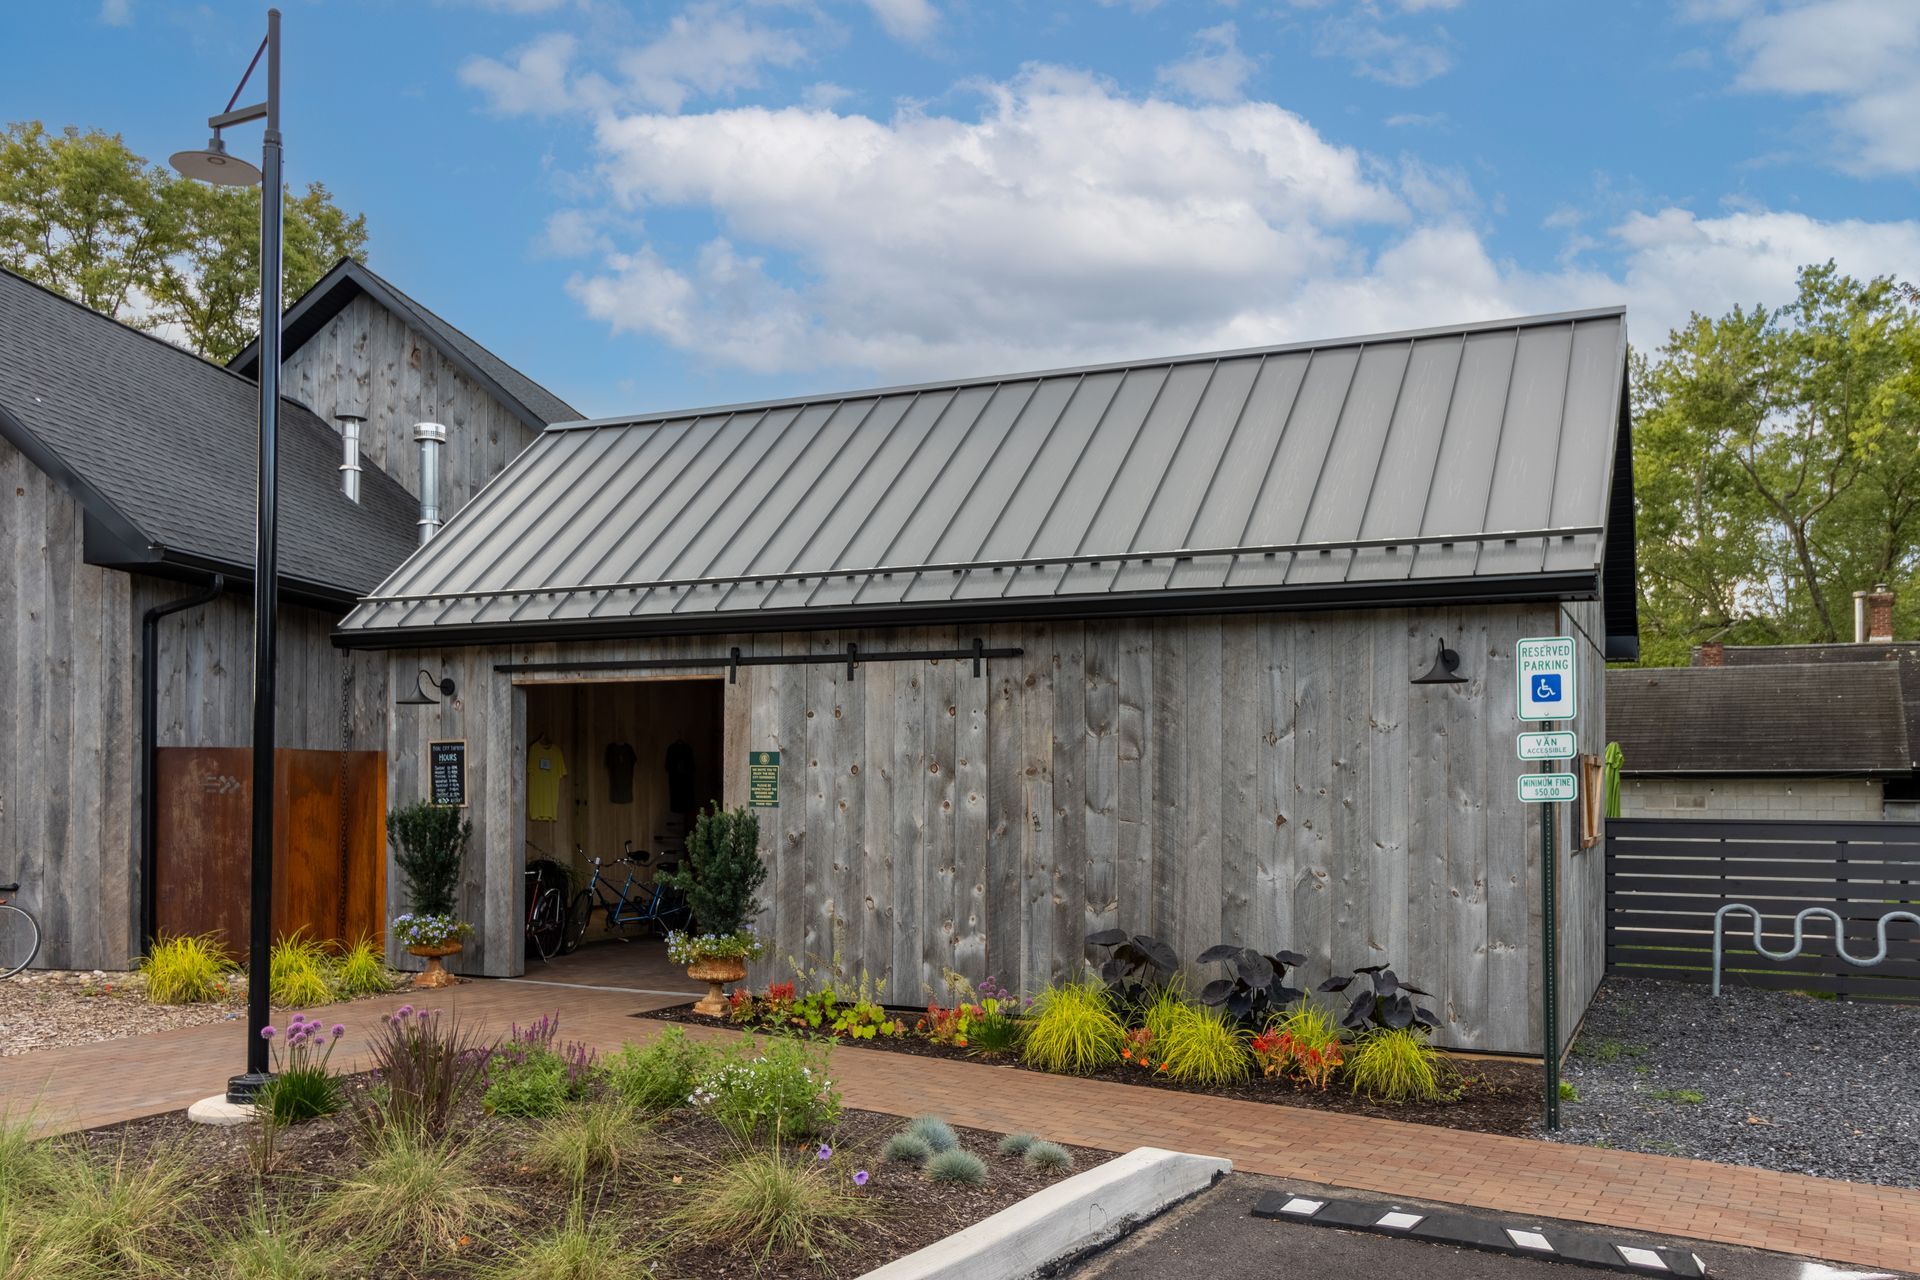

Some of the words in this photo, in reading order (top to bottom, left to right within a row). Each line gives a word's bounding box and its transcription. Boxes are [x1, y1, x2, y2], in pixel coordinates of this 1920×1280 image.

[1522, 645, 1570, 657] RESERVED
[1524, 659, 1568, 671] PARKING
[1536, 738, 1557, 747] VAN
[438, 753, 458, 762] HOURS
[1523, 778, 1553, 788] MINIMUM
[1556, 778, 1571, 787] FINE
[1535, 788, 1560, 797] $50.00
